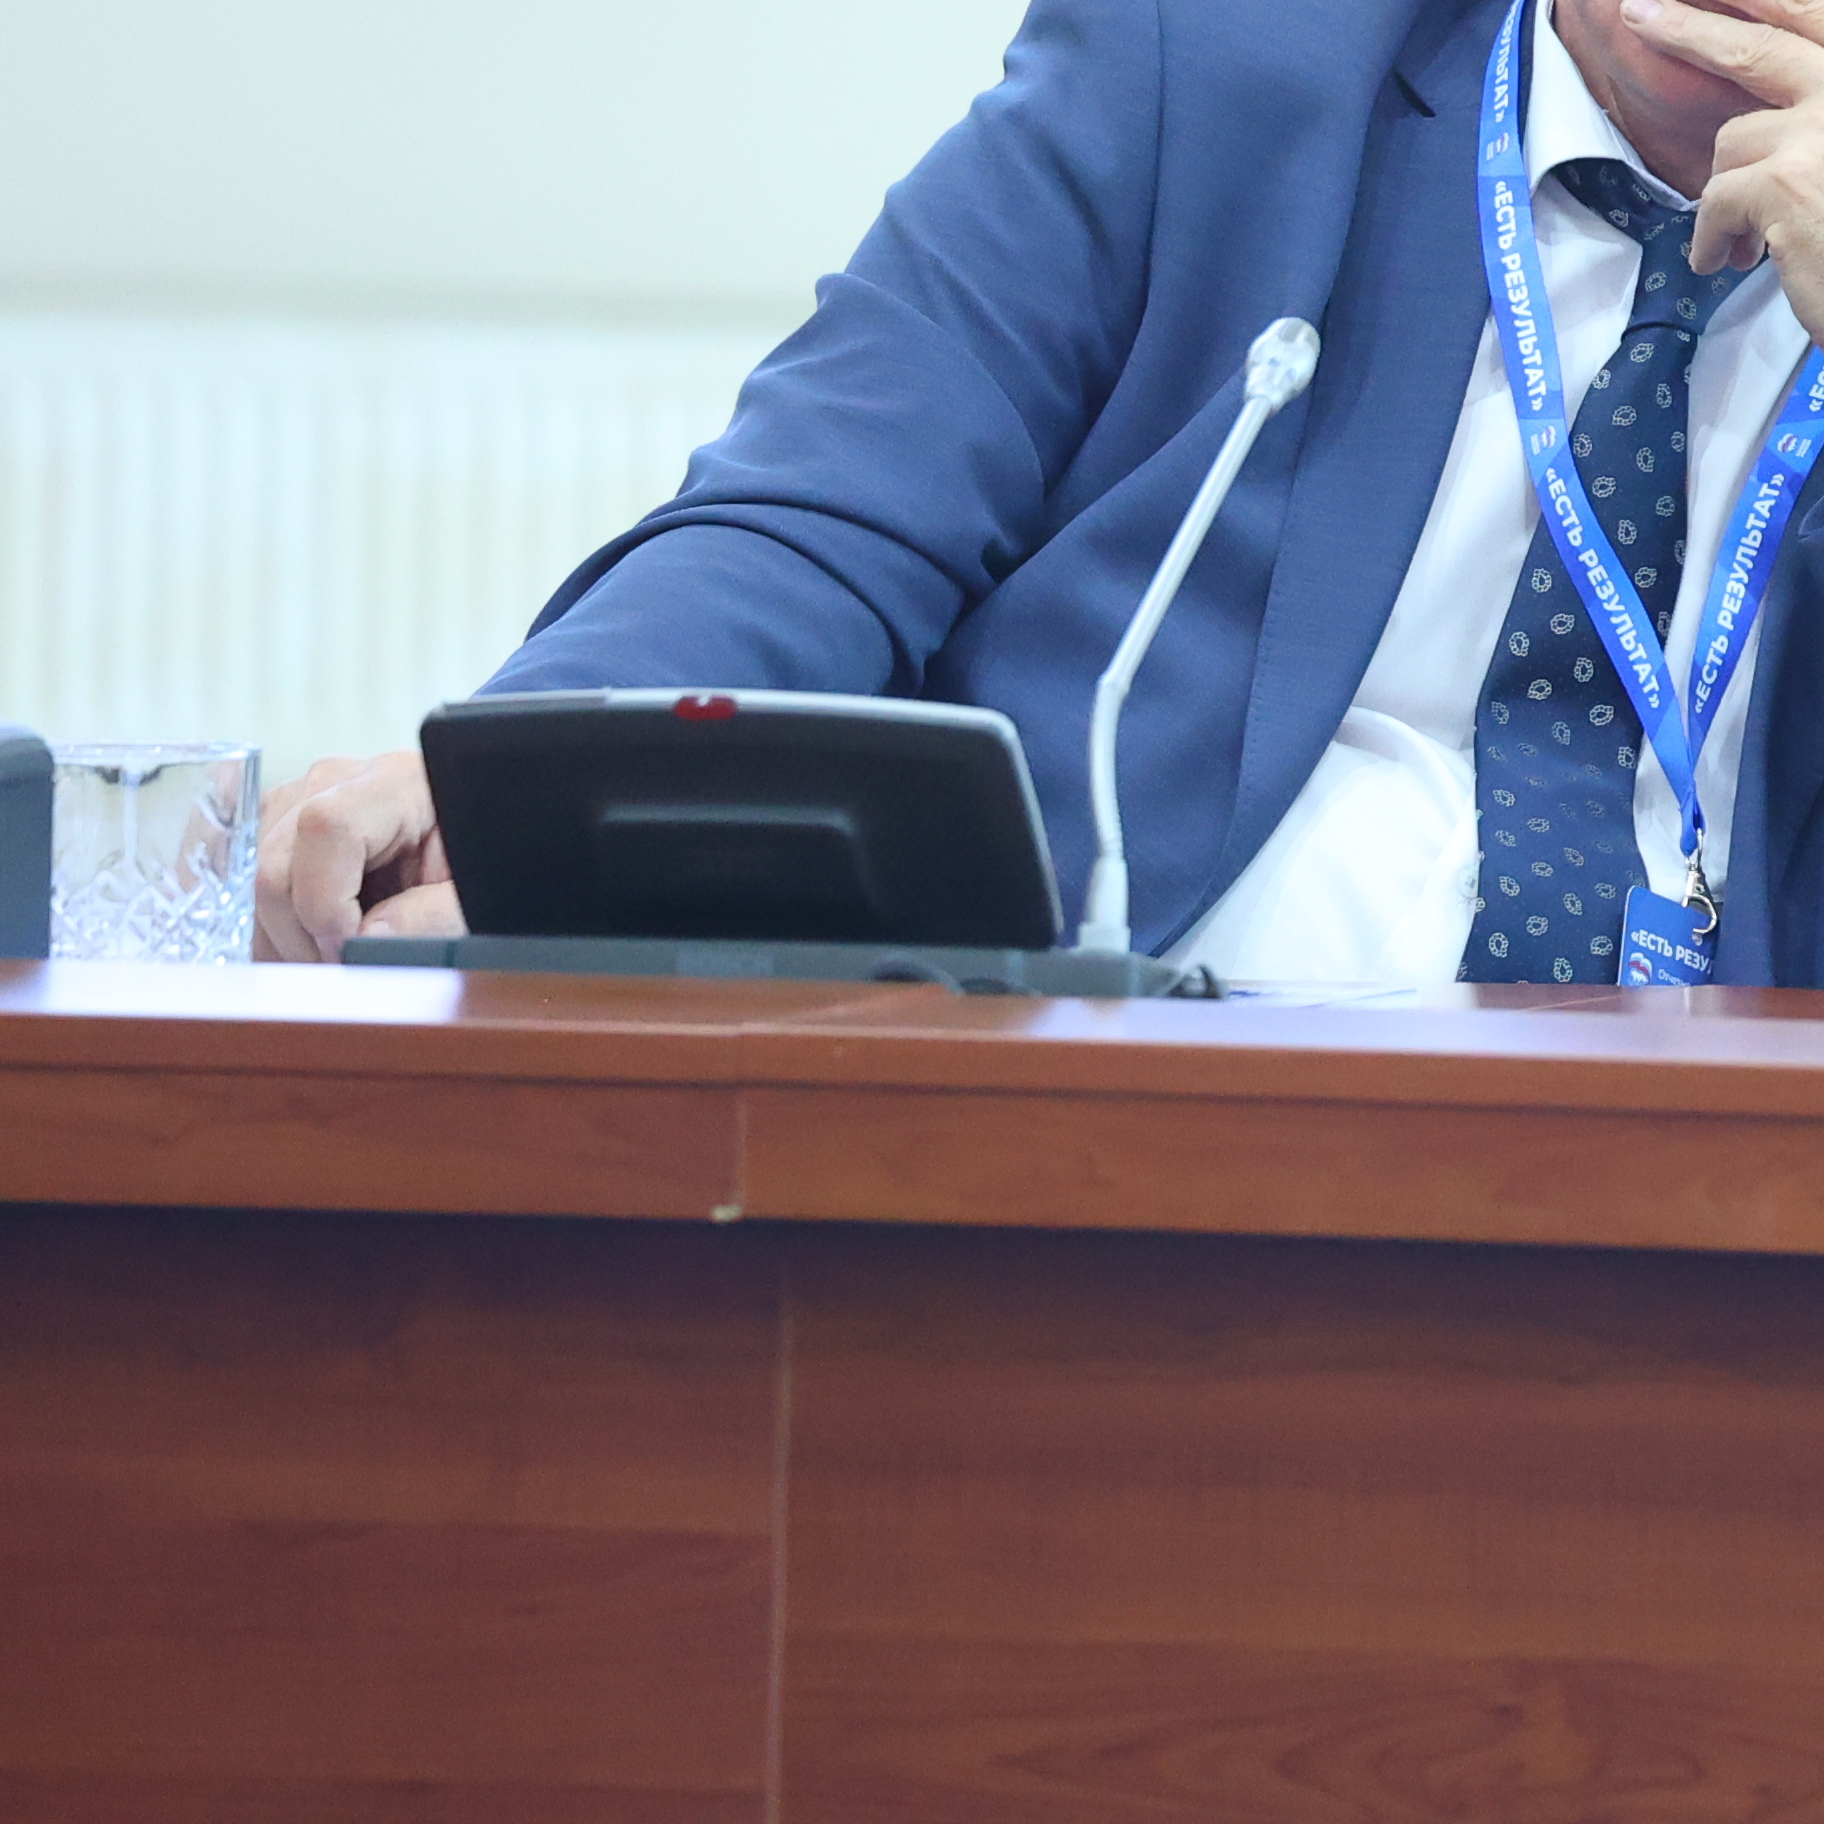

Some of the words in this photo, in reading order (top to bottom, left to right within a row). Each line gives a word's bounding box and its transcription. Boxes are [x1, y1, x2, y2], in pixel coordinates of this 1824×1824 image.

[1494, 180, 1517, 250] «ЕСТЬ
[1500, 252, 1547, 411] РЕЗУЛЬТАТ»
[1546, 467, 1583, 547] «ЕСТЬ
[1578, 548, 1661, 708] РЕЗУЛЬТАТ»
[1694, 634, 1729, 714] «ЕСТЬ
[1717, 472, 1785, 631] РЕЗУЛЬТАТ»
[1631, 929, 1673, 957] «ЕСТЬ
